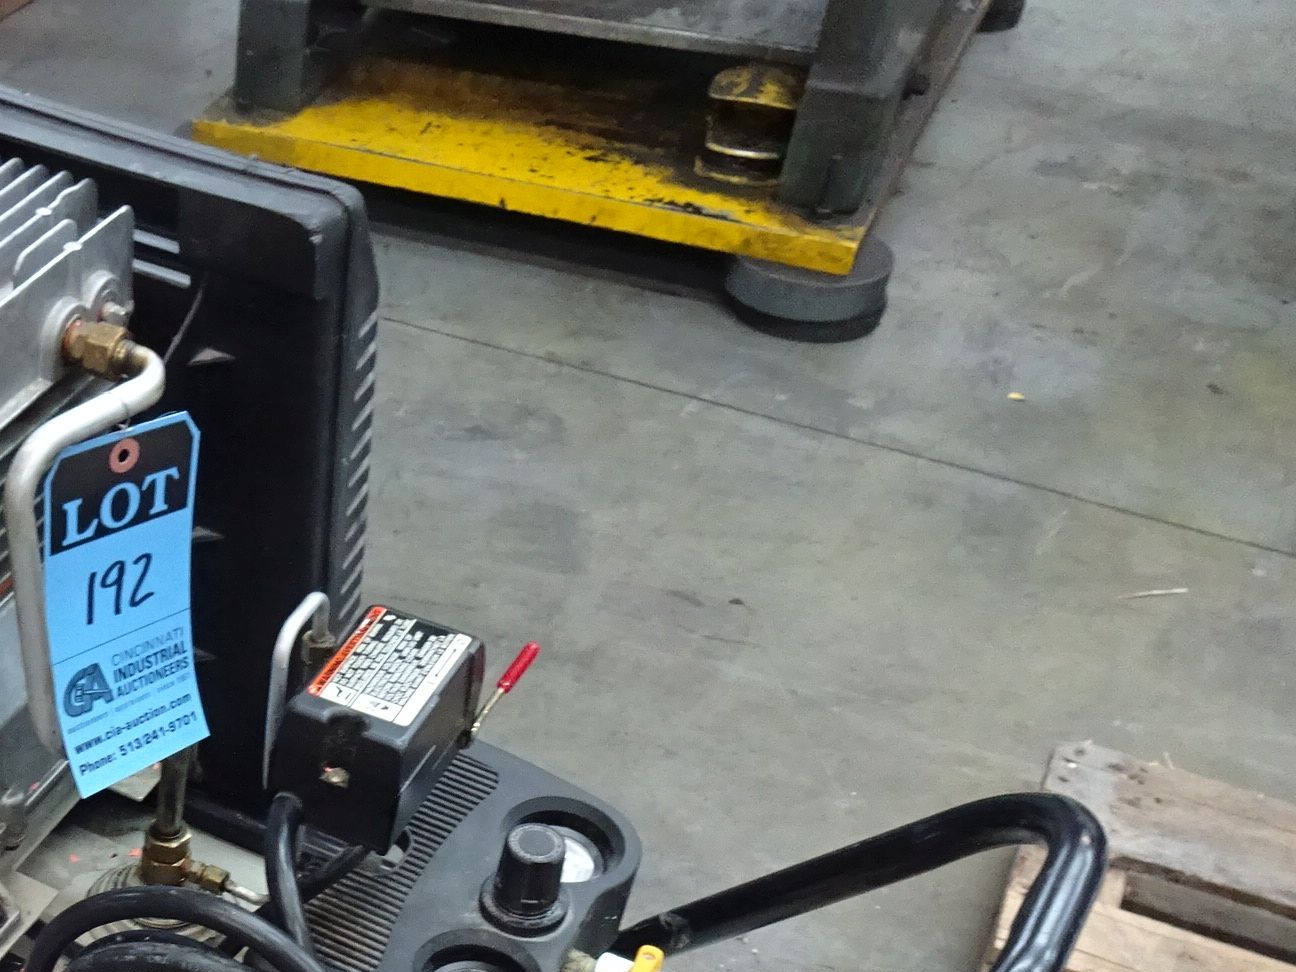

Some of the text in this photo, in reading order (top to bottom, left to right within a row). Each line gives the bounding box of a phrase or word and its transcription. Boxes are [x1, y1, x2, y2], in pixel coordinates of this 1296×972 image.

[62, 466, 180, 546] LOT
[86, 553, 155, 625] 192
[111, 627, 184, 666] CINCINNATI
[113, 641, 187, 683] INDUSTRIAL
[116, 656, 189, 698] AUCTIONEERS
[74, 693, 192, 754] www.cia-auction.com
[79, 751, 117, 776] Phone:
